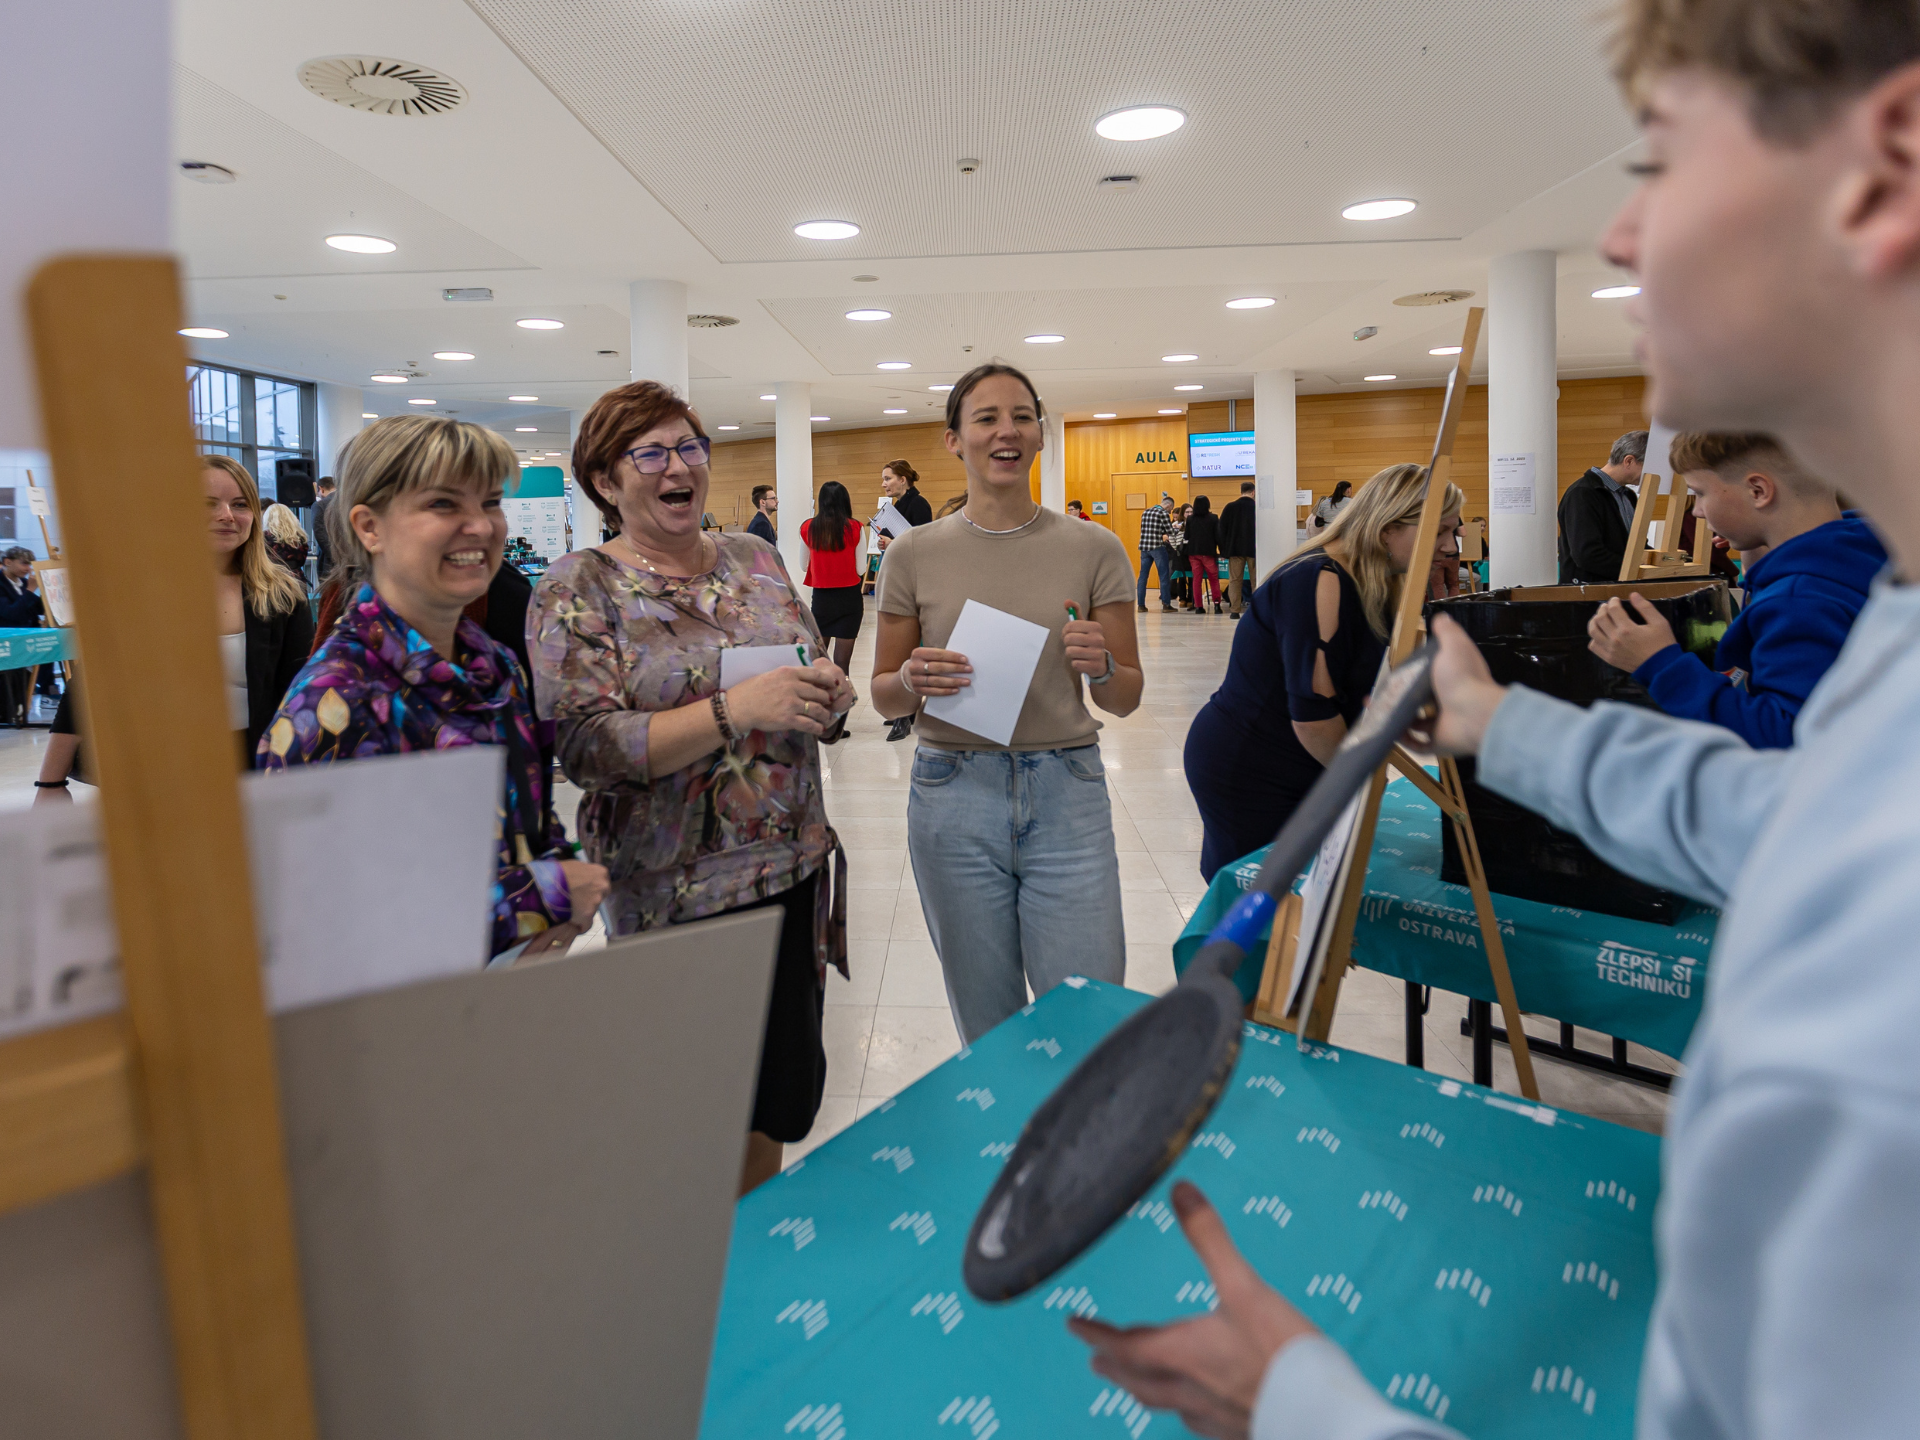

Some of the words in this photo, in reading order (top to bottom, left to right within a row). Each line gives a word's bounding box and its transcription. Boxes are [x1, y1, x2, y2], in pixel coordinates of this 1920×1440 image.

[1135, 450, 1177, 463] AULA
[1399, 917, 1478, 948] OSTRAVA
[1402, 901, 1516, 936] UNIVERZTA
[1595, 962, 1691, 998] TECHNIKU
[1672, 963, 1692, 983] SI
